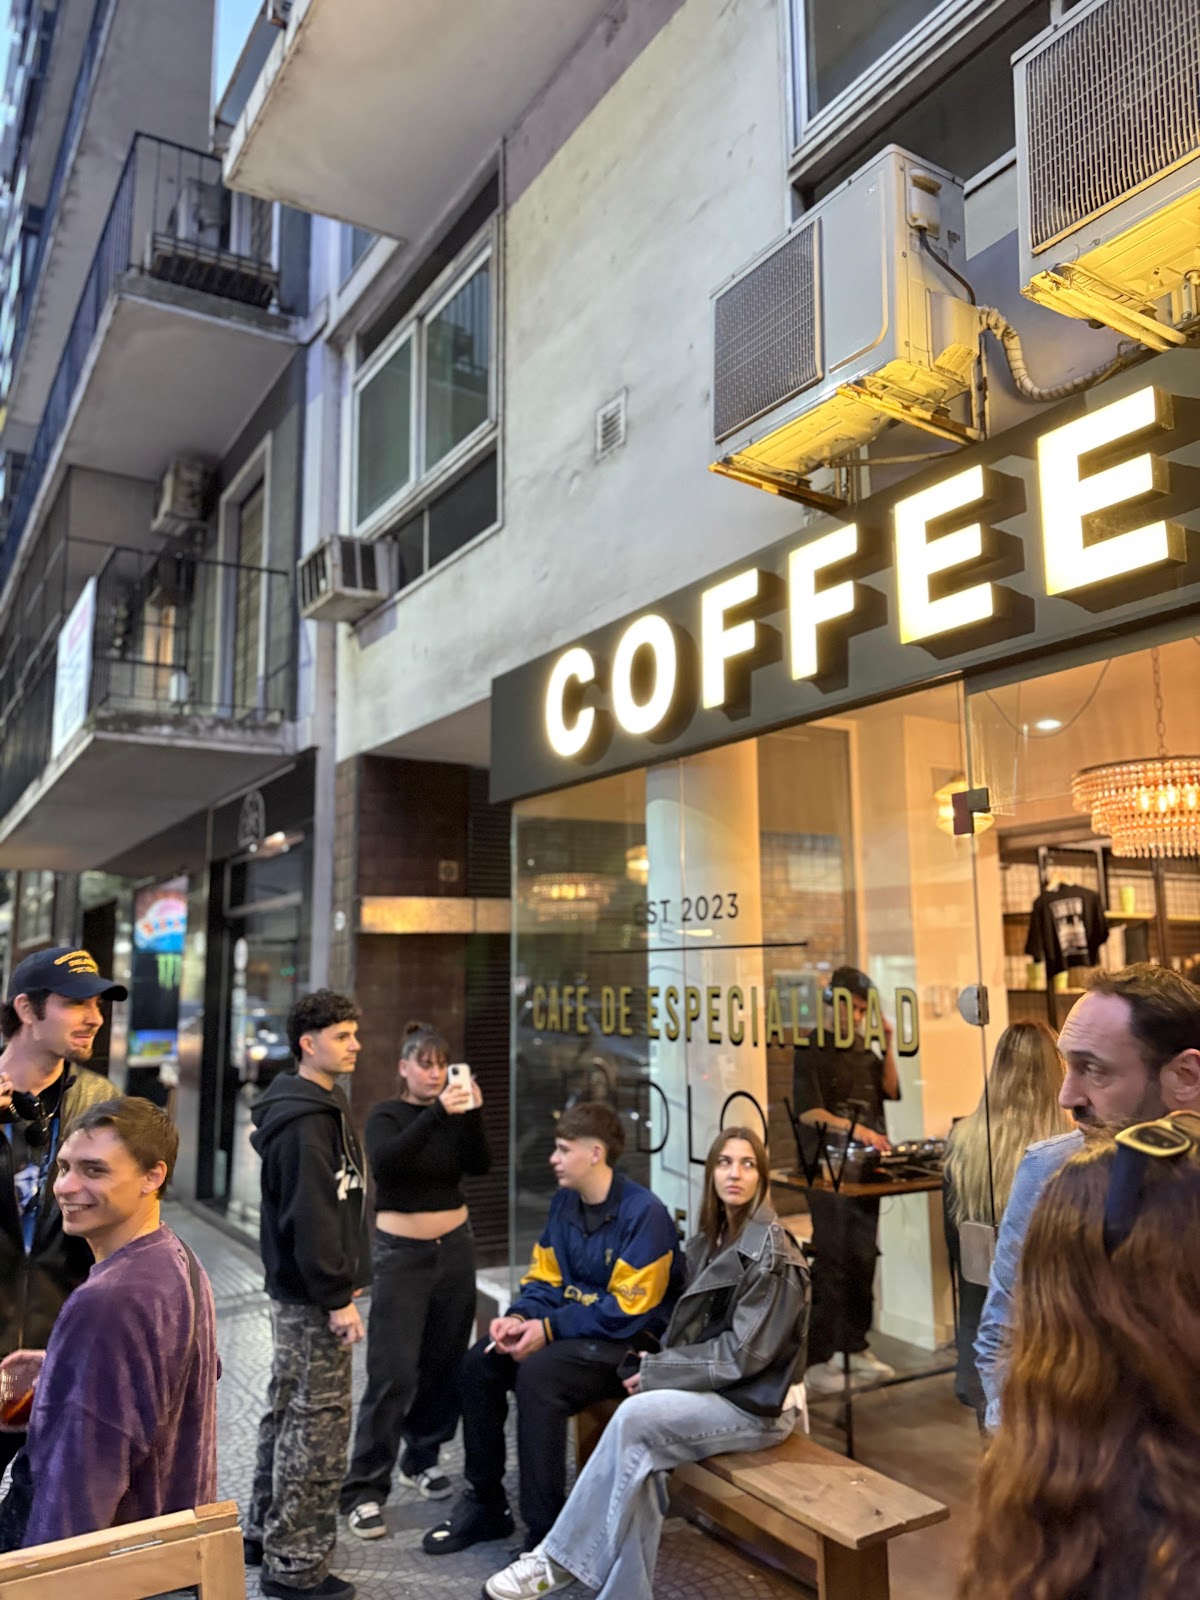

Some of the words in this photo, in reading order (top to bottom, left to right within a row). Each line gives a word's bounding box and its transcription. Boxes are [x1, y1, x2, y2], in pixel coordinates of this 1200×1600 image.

[545, 386, 1169, 757] COFFEE
[633, 899, 670, 926] EST
[681, 892, 739, 921] 2023
[601, 985, 633, 1036] DE
[647, 985, 921, 1056] ESPECIALIDAD
